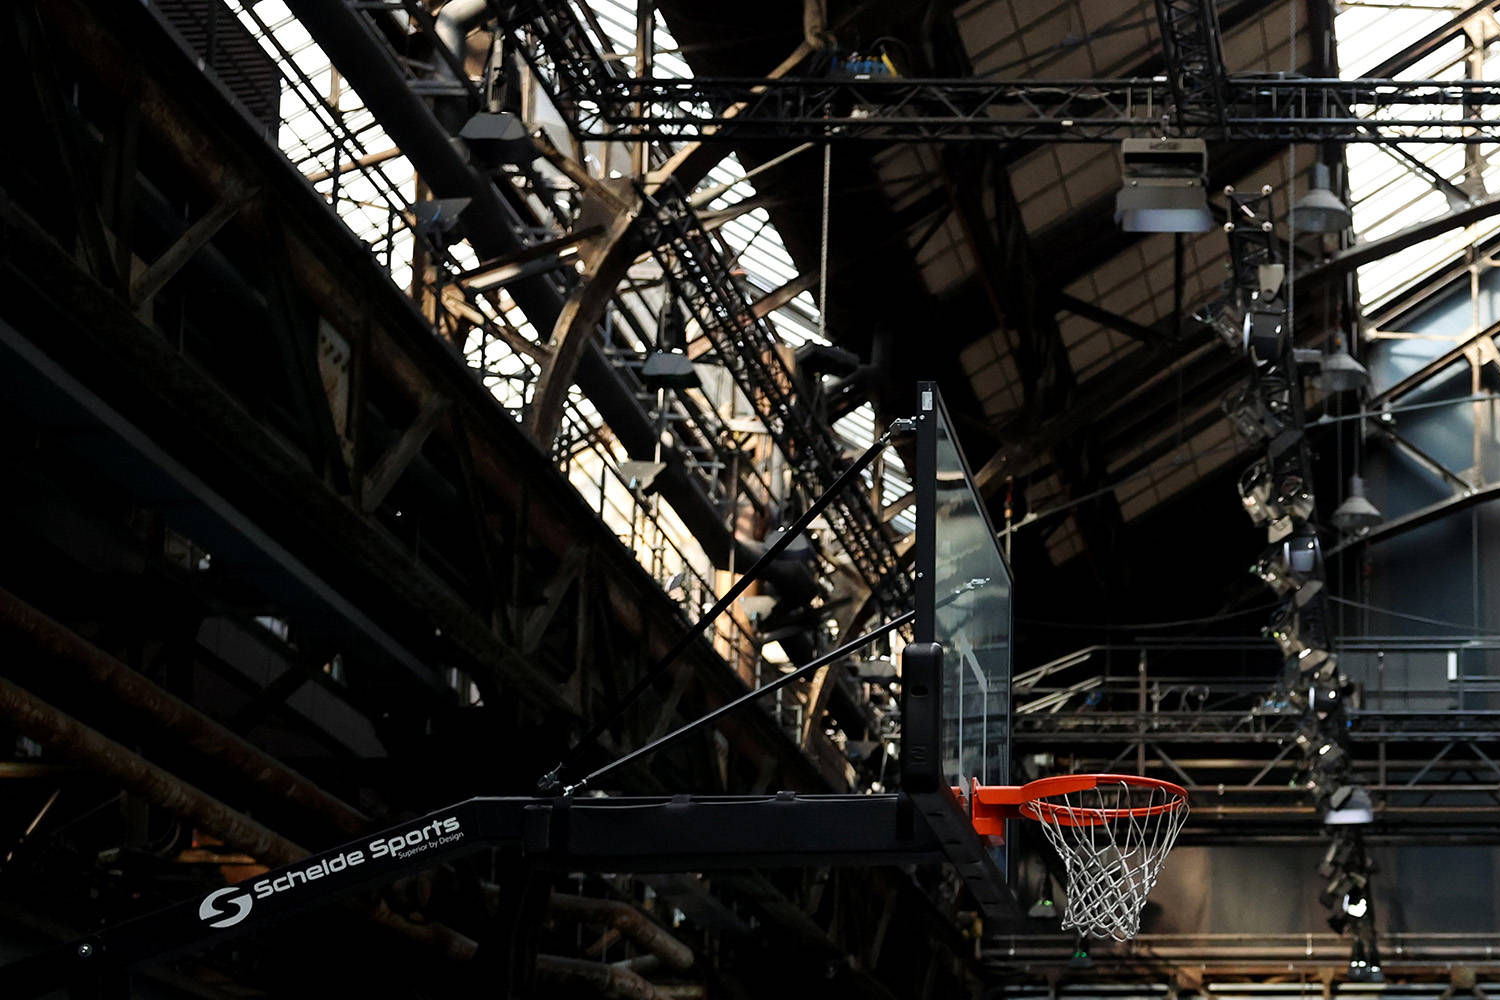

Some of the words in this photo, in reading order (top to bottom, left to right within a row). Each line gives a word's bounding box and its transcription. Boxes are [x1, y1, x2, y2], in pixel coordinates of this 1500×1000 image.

[254, 850, 365, 899] Schelde
[369, 816, 460, 858] Sports
[398, 844, 428, 859] Superior
[429, 840, 438, 849] by
[439, 832, 464, 844] Design
